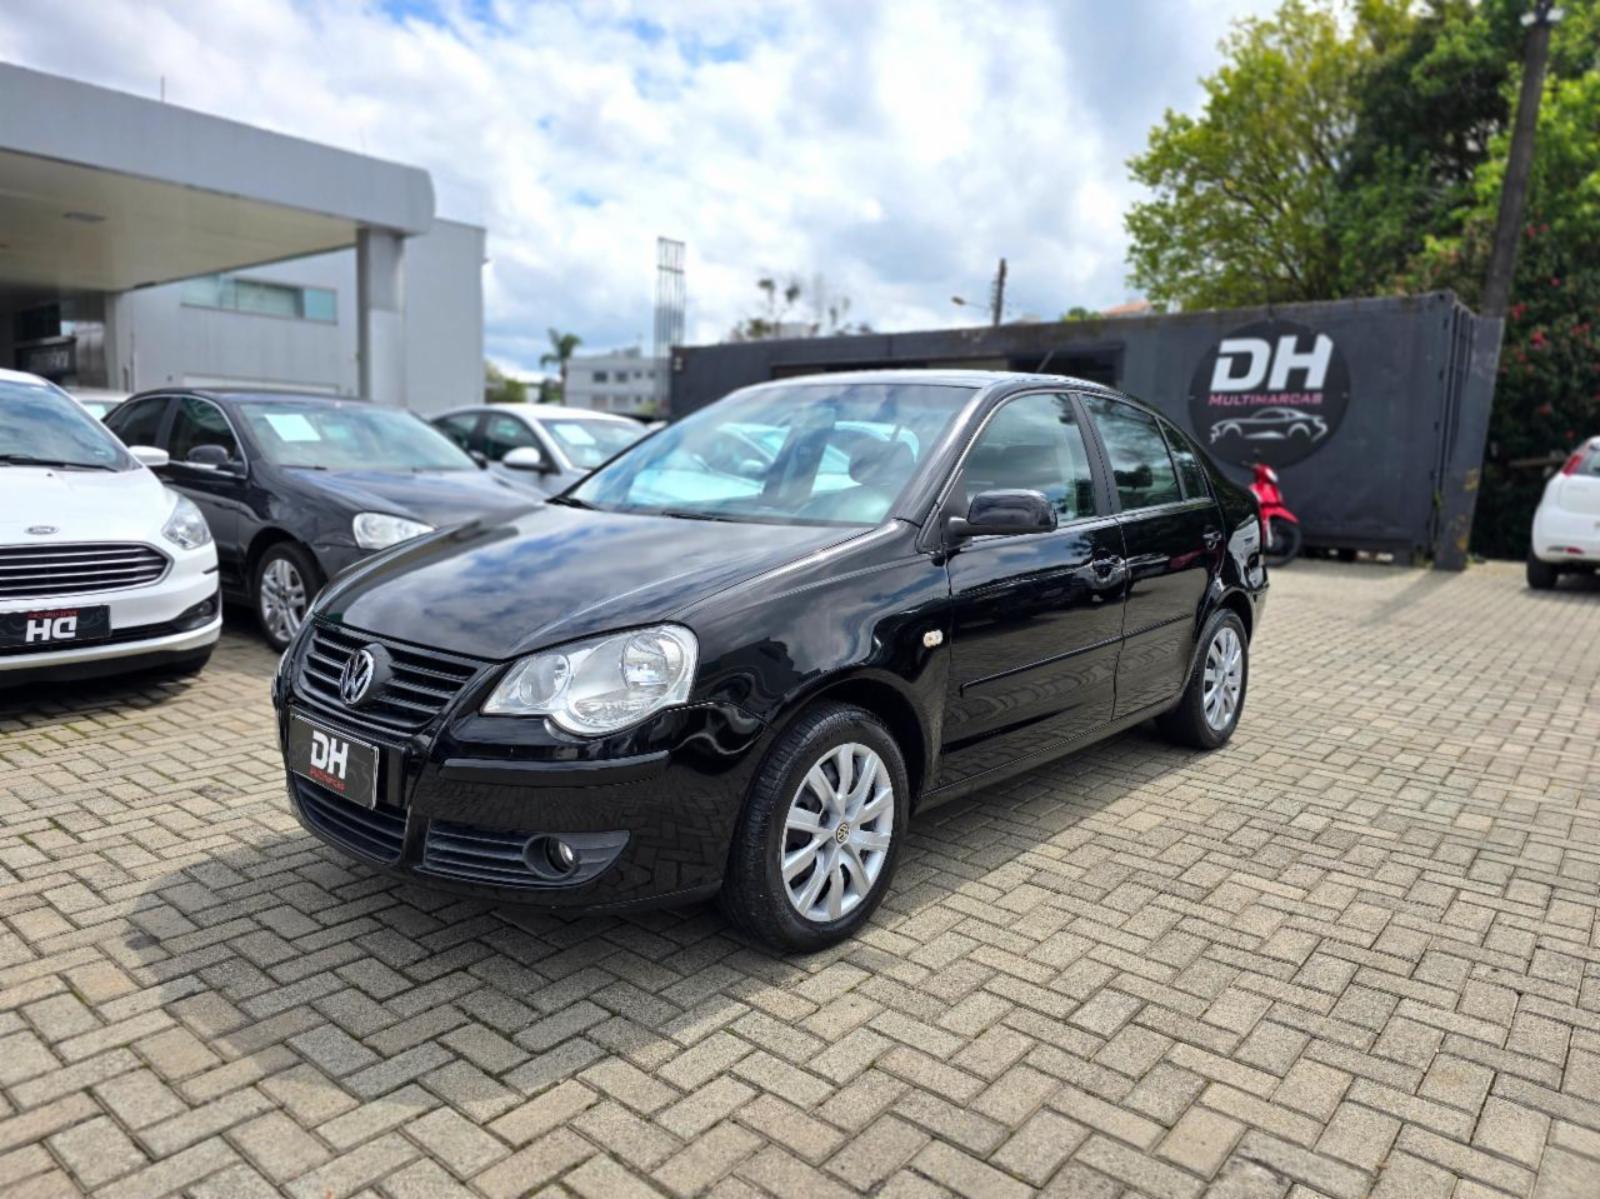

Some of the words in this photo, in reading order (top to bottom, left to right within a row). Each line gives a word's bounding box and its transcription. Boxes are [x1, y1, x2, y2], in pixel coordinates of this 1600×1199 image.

[1210, 334, 1333, 391] DH
[1208, 393, 1323, 406] MULTIMARCAS
[310, 730, 349, 779] DH
